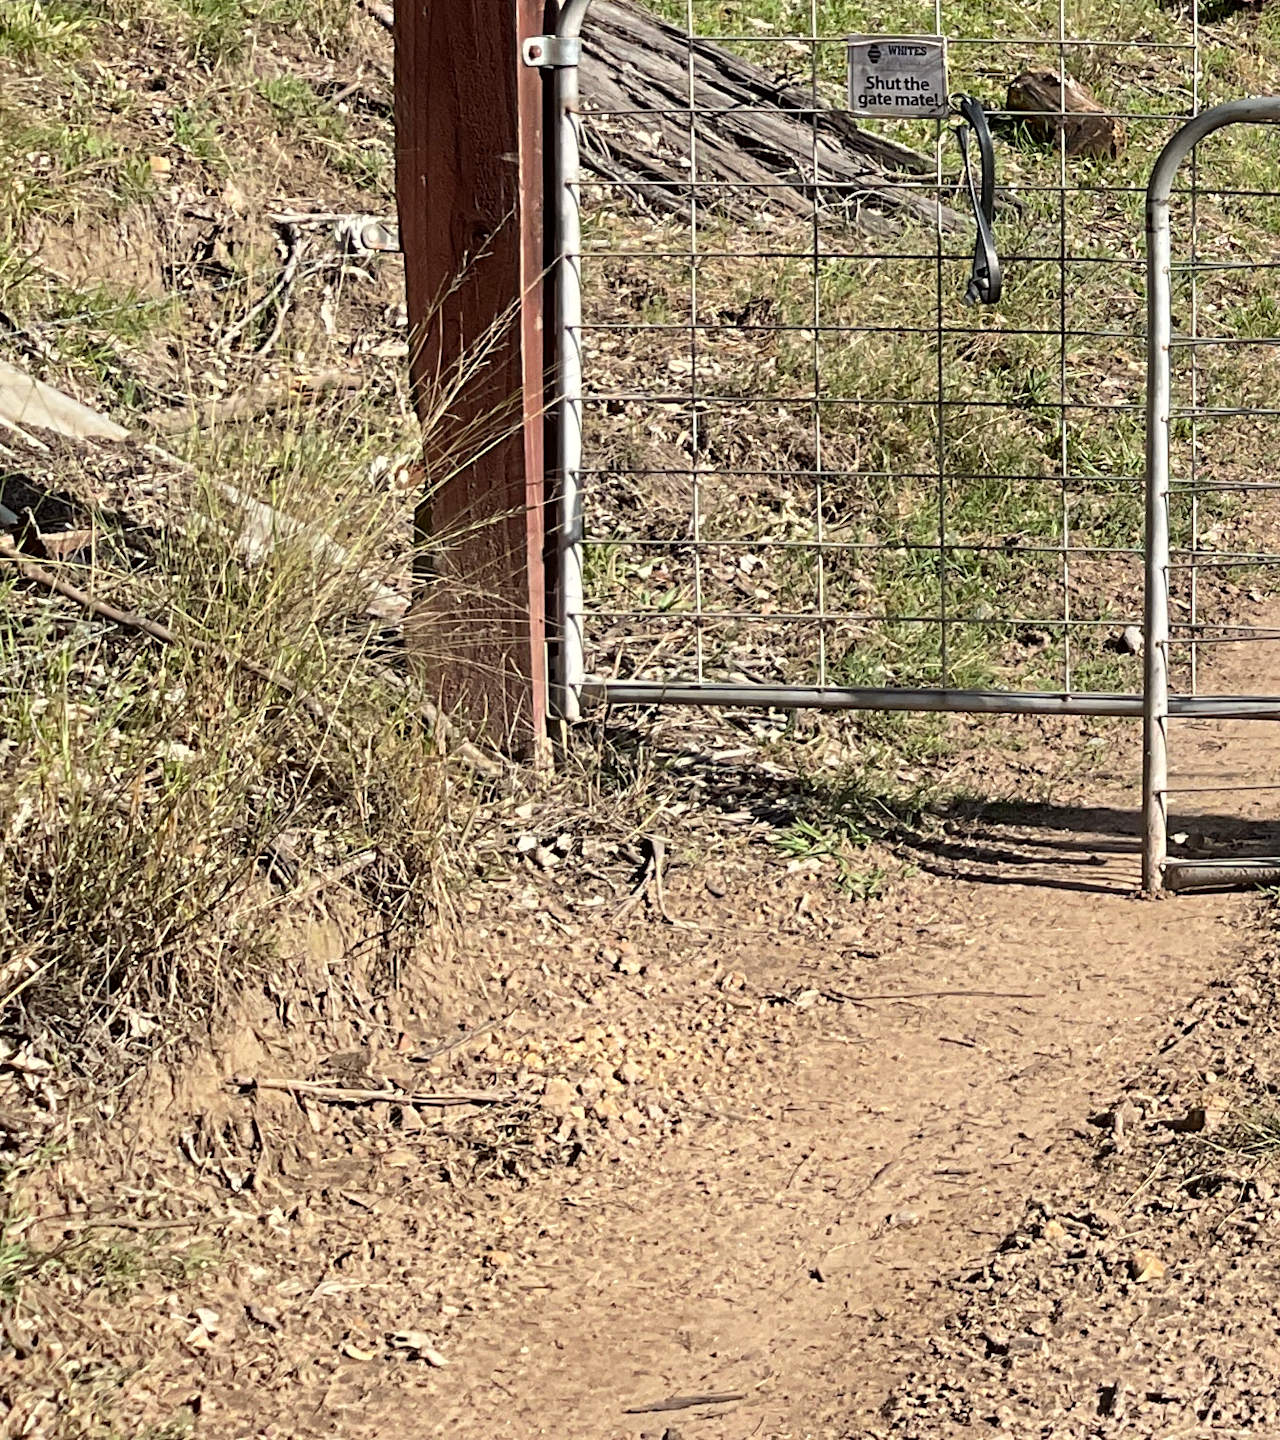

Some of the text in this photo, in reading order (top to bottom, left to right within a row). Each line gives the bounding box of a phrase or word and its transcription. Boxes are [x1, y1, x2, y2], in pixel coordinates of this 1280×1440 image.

[888, 45, 927, 56] WHITES
[866, 76, 930, 91] Shut the
[858, 93, 939, 108] gate mate!
